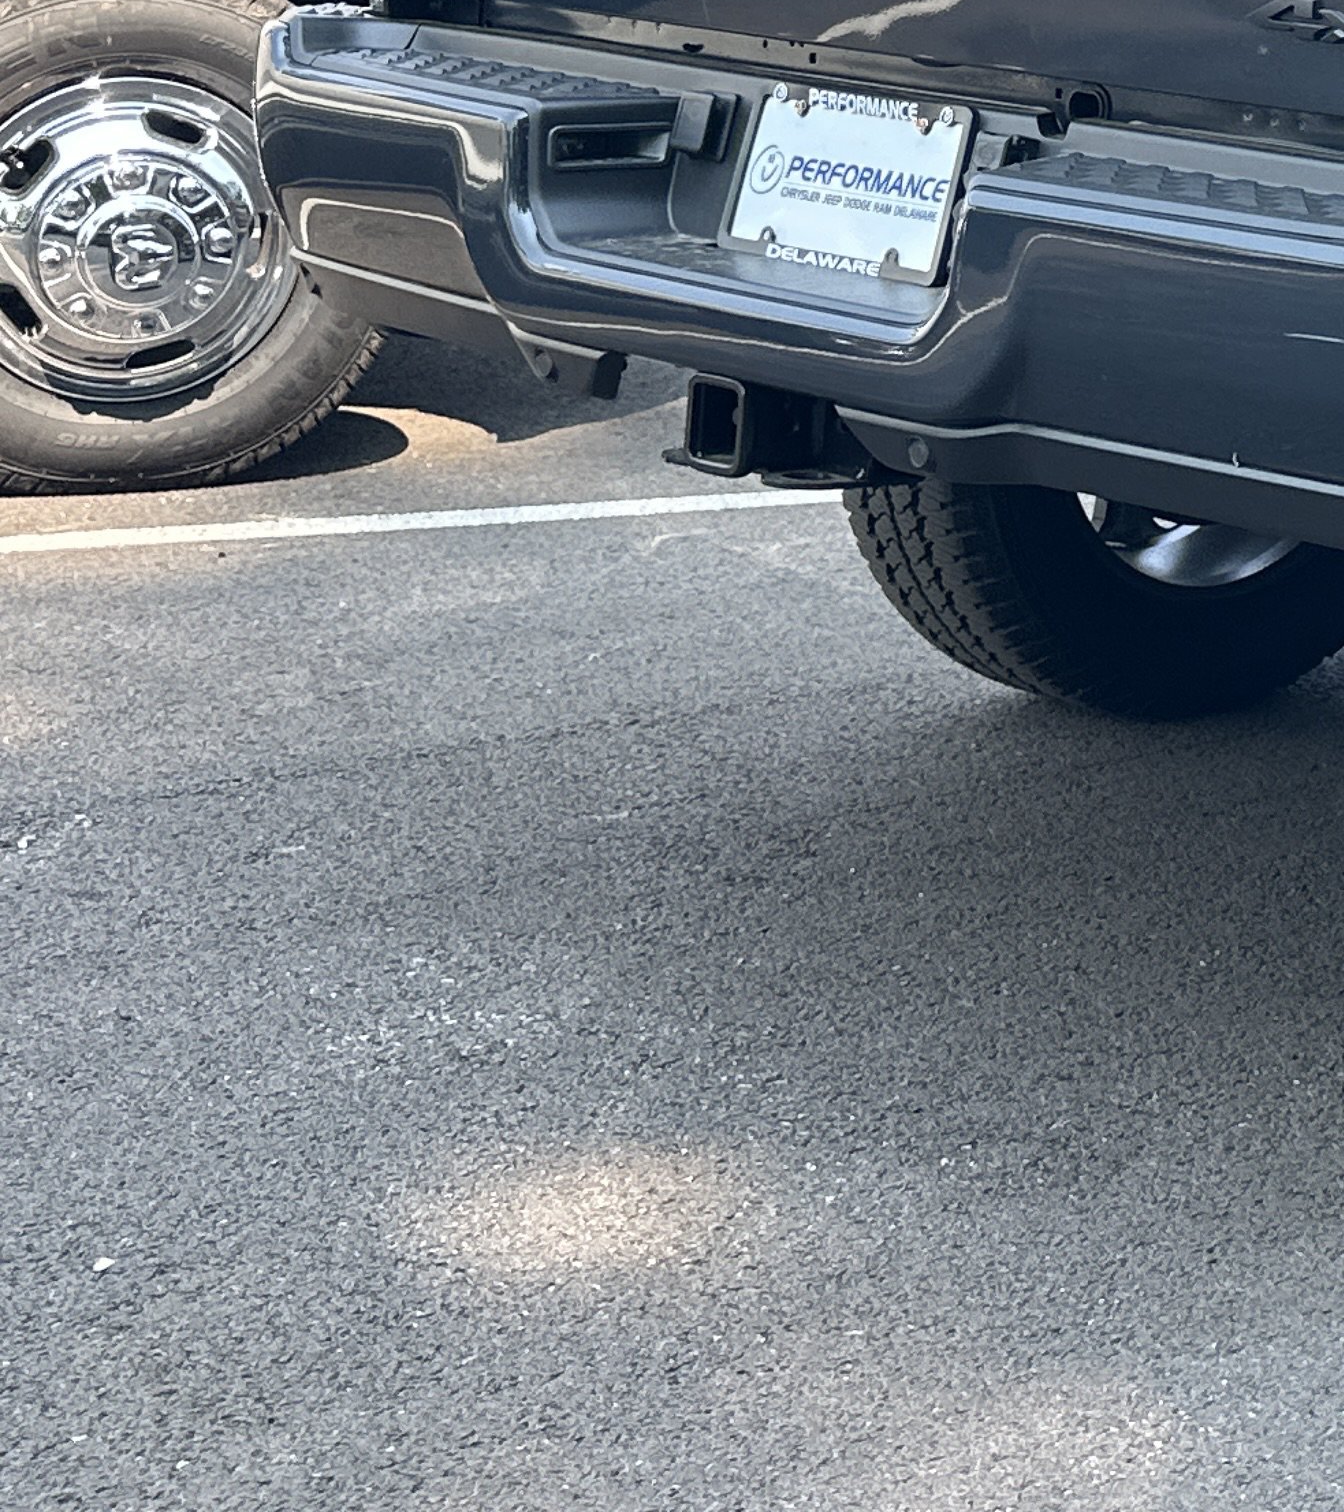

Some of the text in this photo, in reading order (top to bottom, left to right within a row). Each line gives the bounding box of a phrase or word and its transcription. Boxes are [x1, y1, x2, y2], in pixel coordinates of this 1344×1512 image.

[807, 88, 919, 122] PERFORMANCE
[785, 154, 950, 204] PERFORMANCE
[765, 242, 881, 277] DELAWARE
